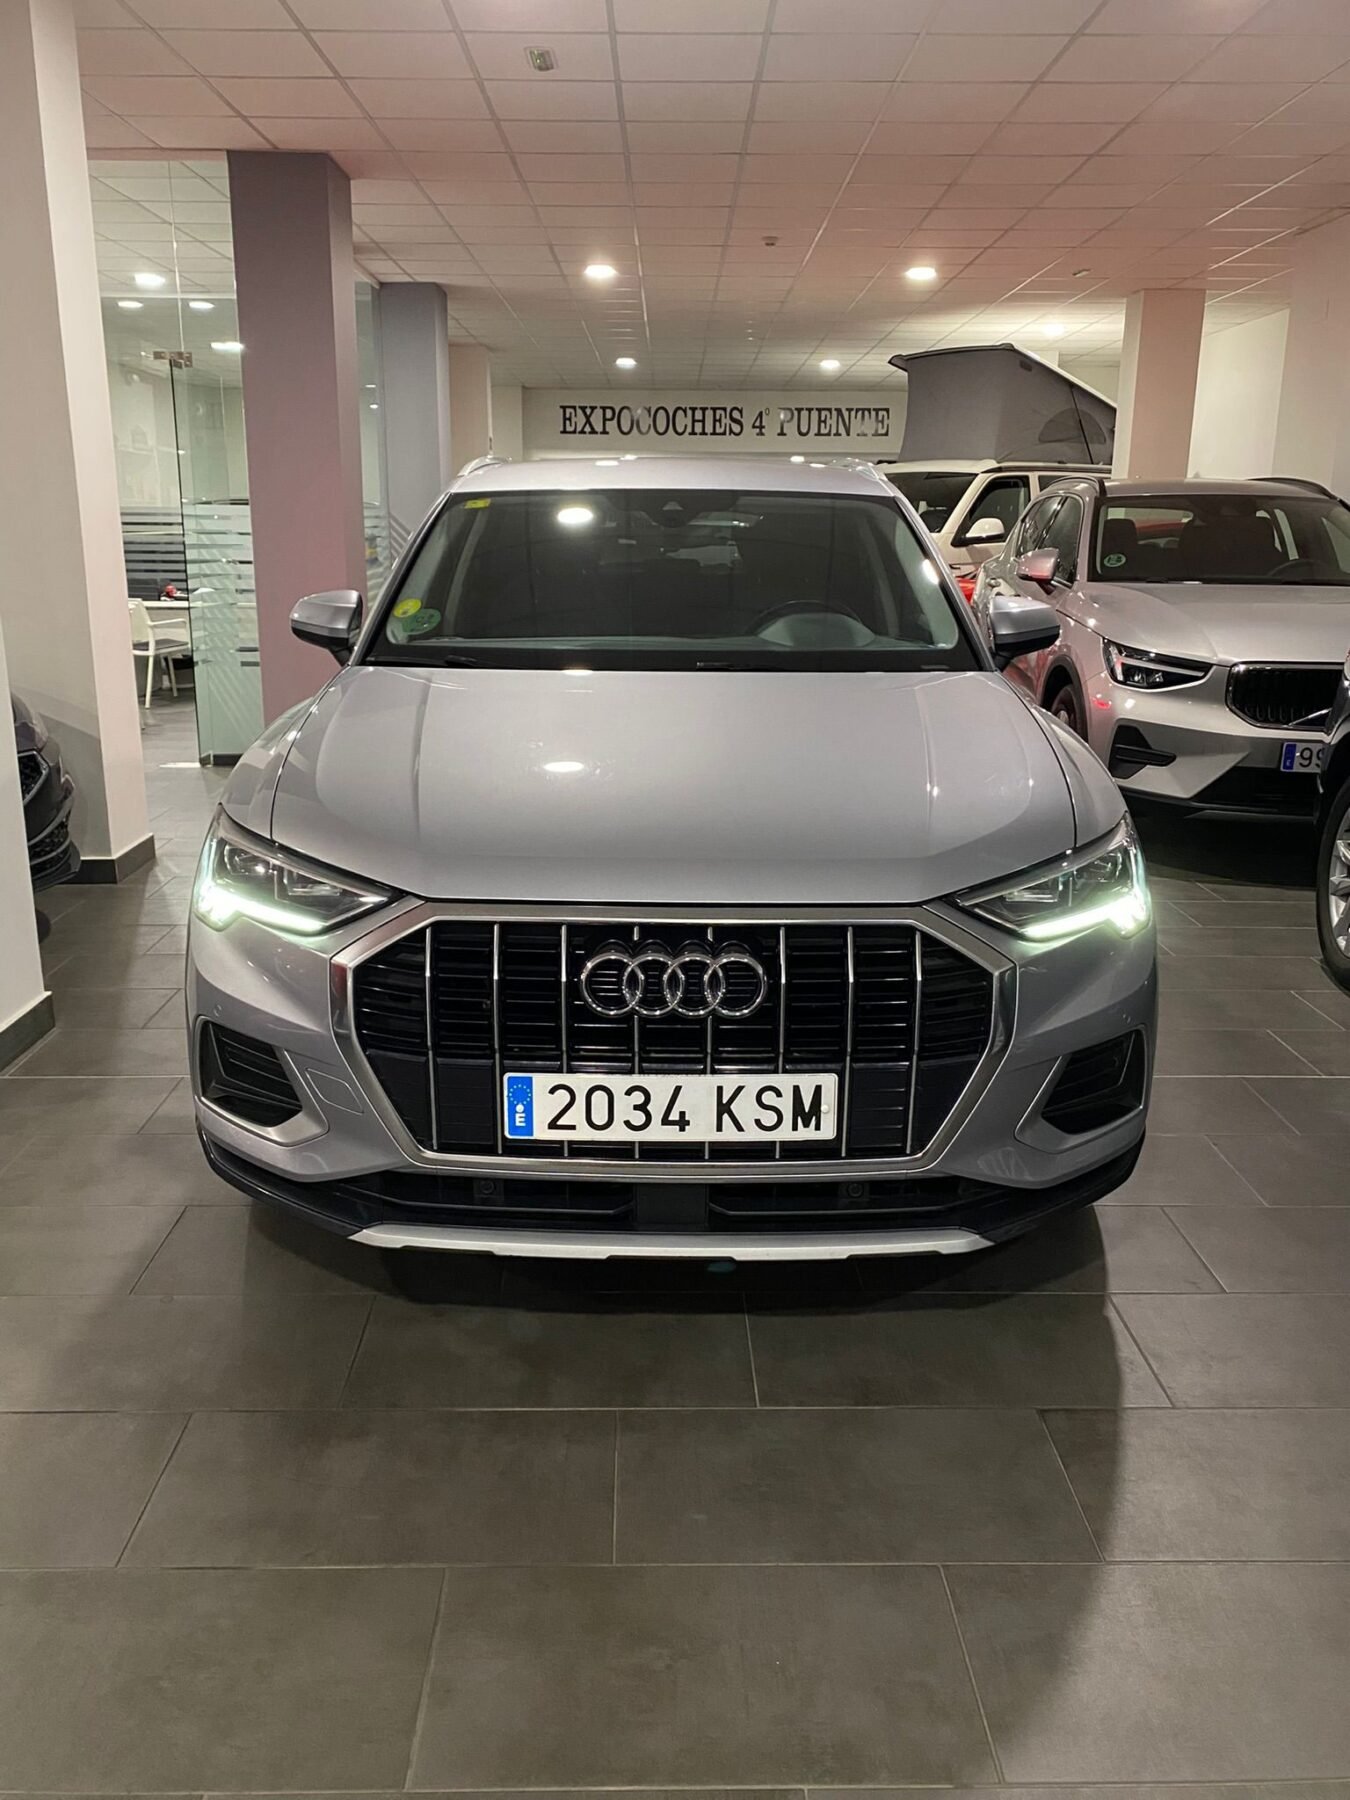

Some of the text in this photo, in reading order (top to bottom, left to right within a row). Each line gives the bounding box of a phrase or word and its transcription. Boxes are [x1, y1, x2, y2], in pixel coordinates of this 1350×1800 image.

[559, 405, 744, 436] EXPOCOCHES
[777, 407, 890, 437] PUENTE
[515, 1084, 823, 1133] E 2034 KSM
